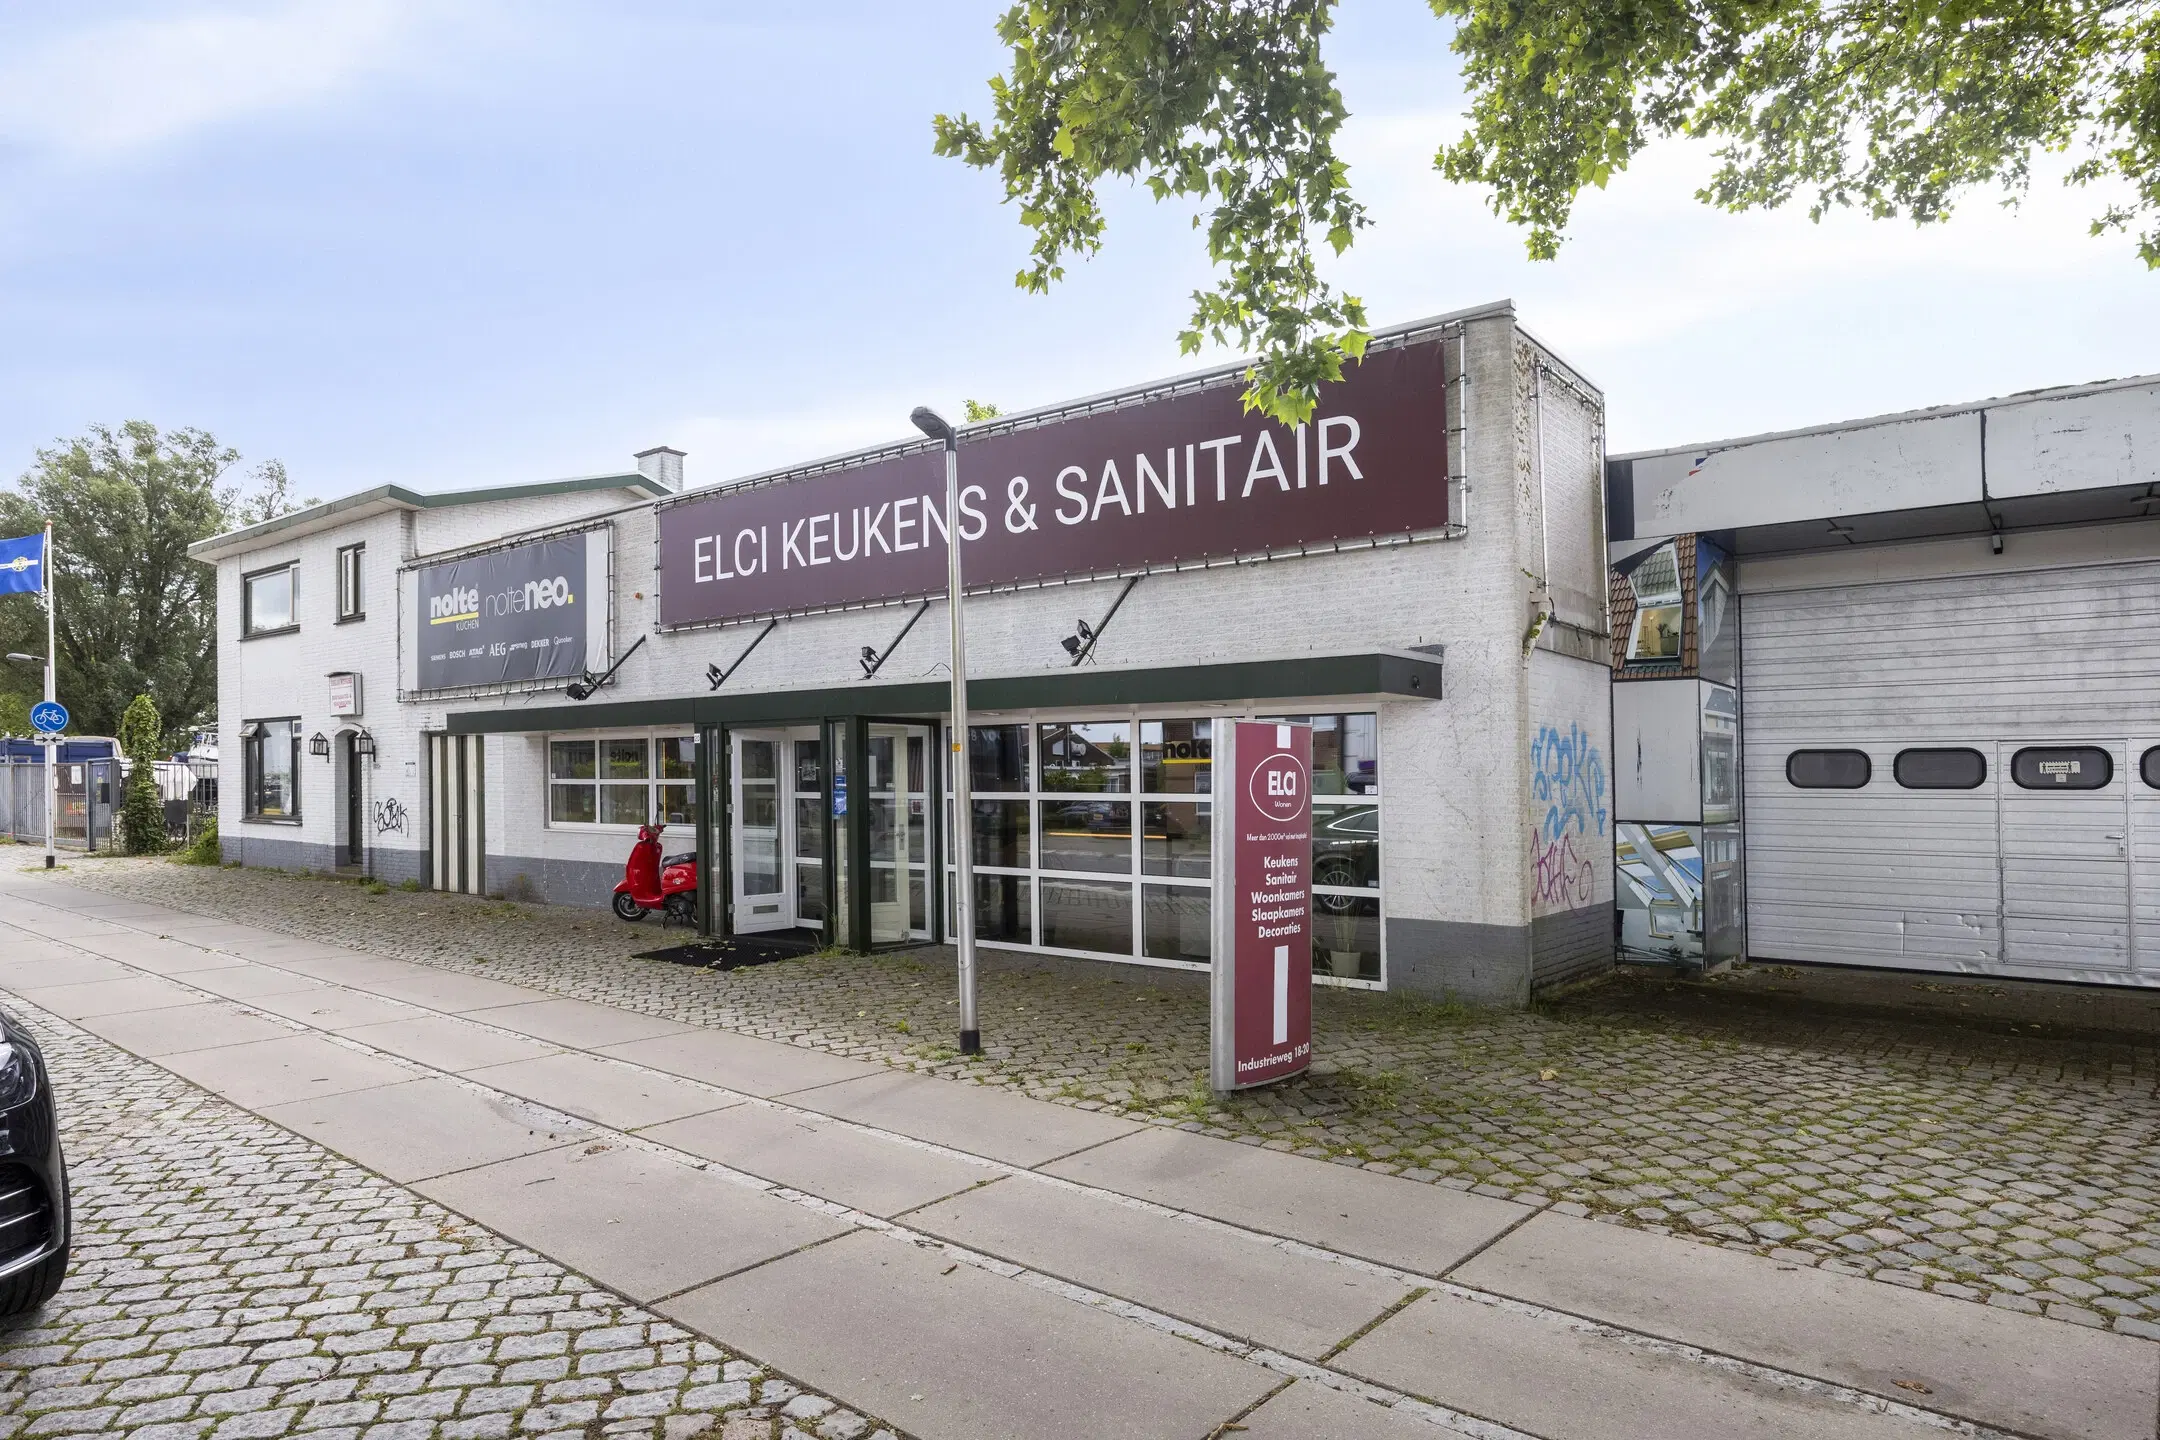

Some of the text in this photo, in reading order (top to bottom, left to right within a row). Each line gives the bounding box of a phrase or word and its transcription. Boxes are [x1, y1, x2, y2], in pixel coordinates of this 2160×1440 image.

[693, 415, 1364, 583] ELCI KEUKENS & SANITAIR
[430, 583, 479, 618] nolte
[455, 619, 479, 632] KÜCHEN
[449, 649, 466, 659] BOSCH
[488, 642, 507, 657] AEG
[530, 638, 550, 649] DEKKER
[1164, 739, 1211, 759] nolt
[1268, 770, 1296, 796] ELCI
[1274, 800, 1292, 808] Wonen
[1264, 855, 1299, 869] Keukens
[1265, 872, 1297, 886] Sanitair
[1251, 889, 1305, 904] Woonkamers
[1251, 906, 1305, 923] Slaapkamers
[1258, 922, 1301, 938] Decoraties
[1238, 1042, 1310, 1072] Industrieweg 18-20
